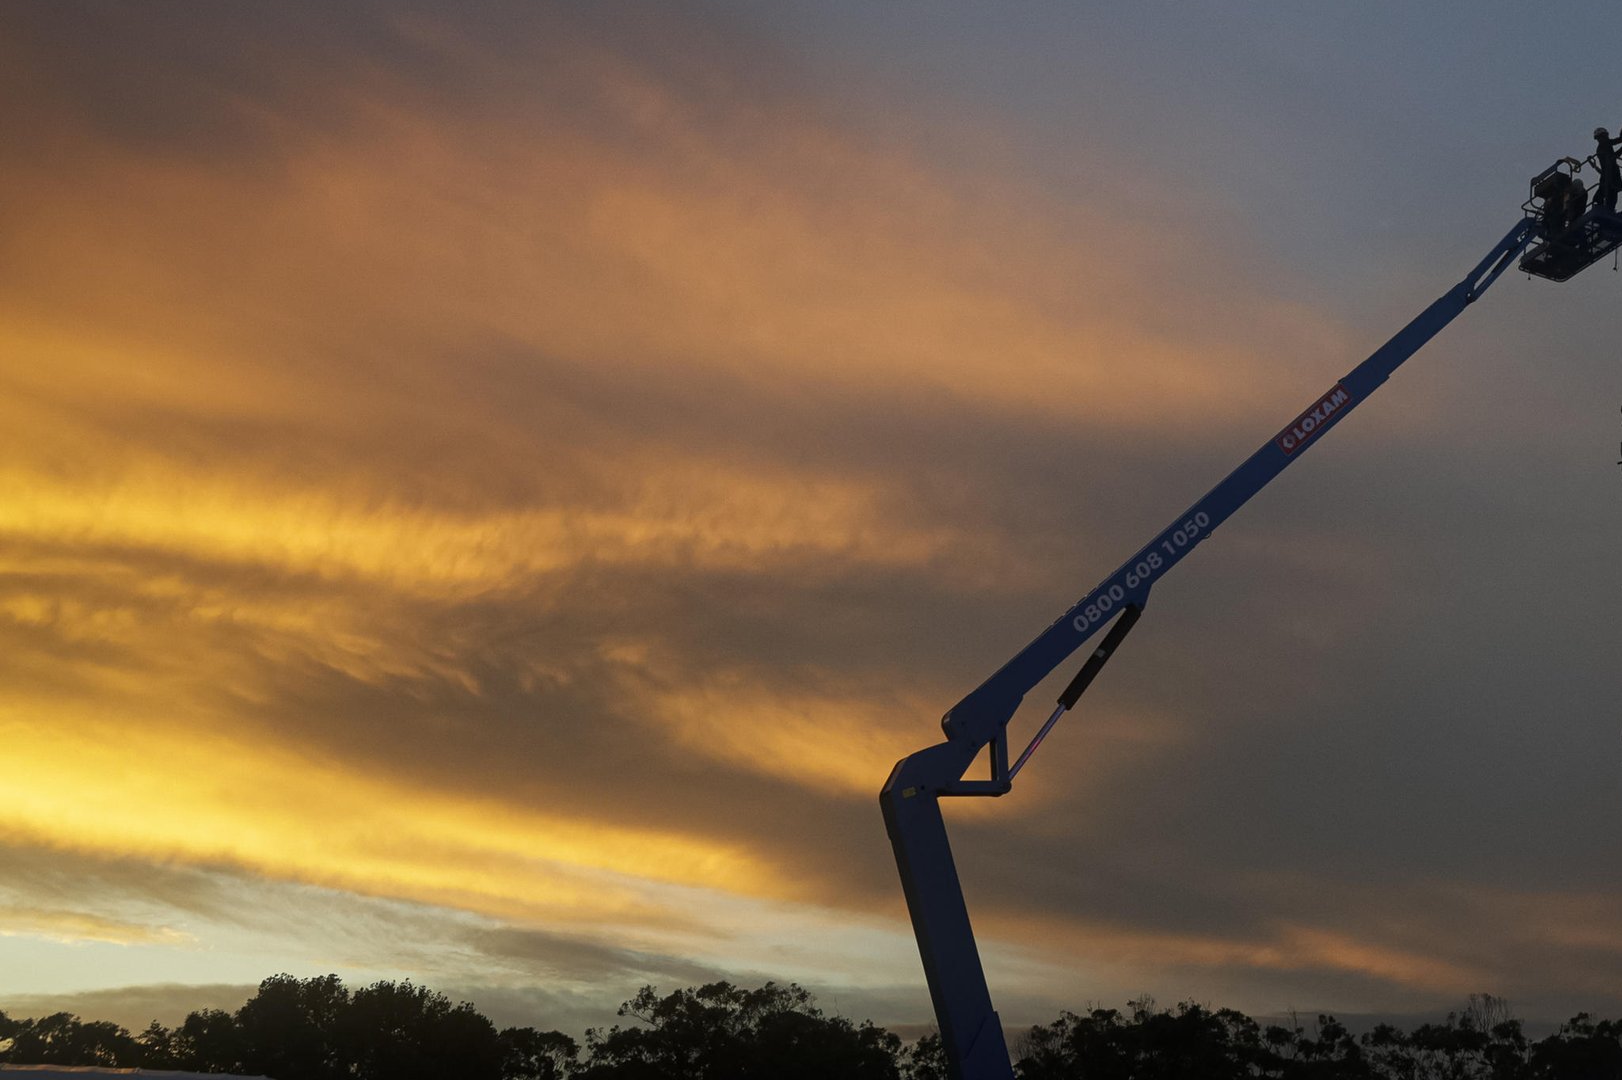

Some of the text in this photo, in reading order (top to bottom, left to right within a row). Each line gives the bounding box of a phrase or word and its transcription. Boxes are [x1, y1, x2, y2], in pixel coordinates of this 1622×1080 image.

[1293, 389, 1348, 440] LOXAM
[1072, 511, 1210, 632] 0800 608 1050
